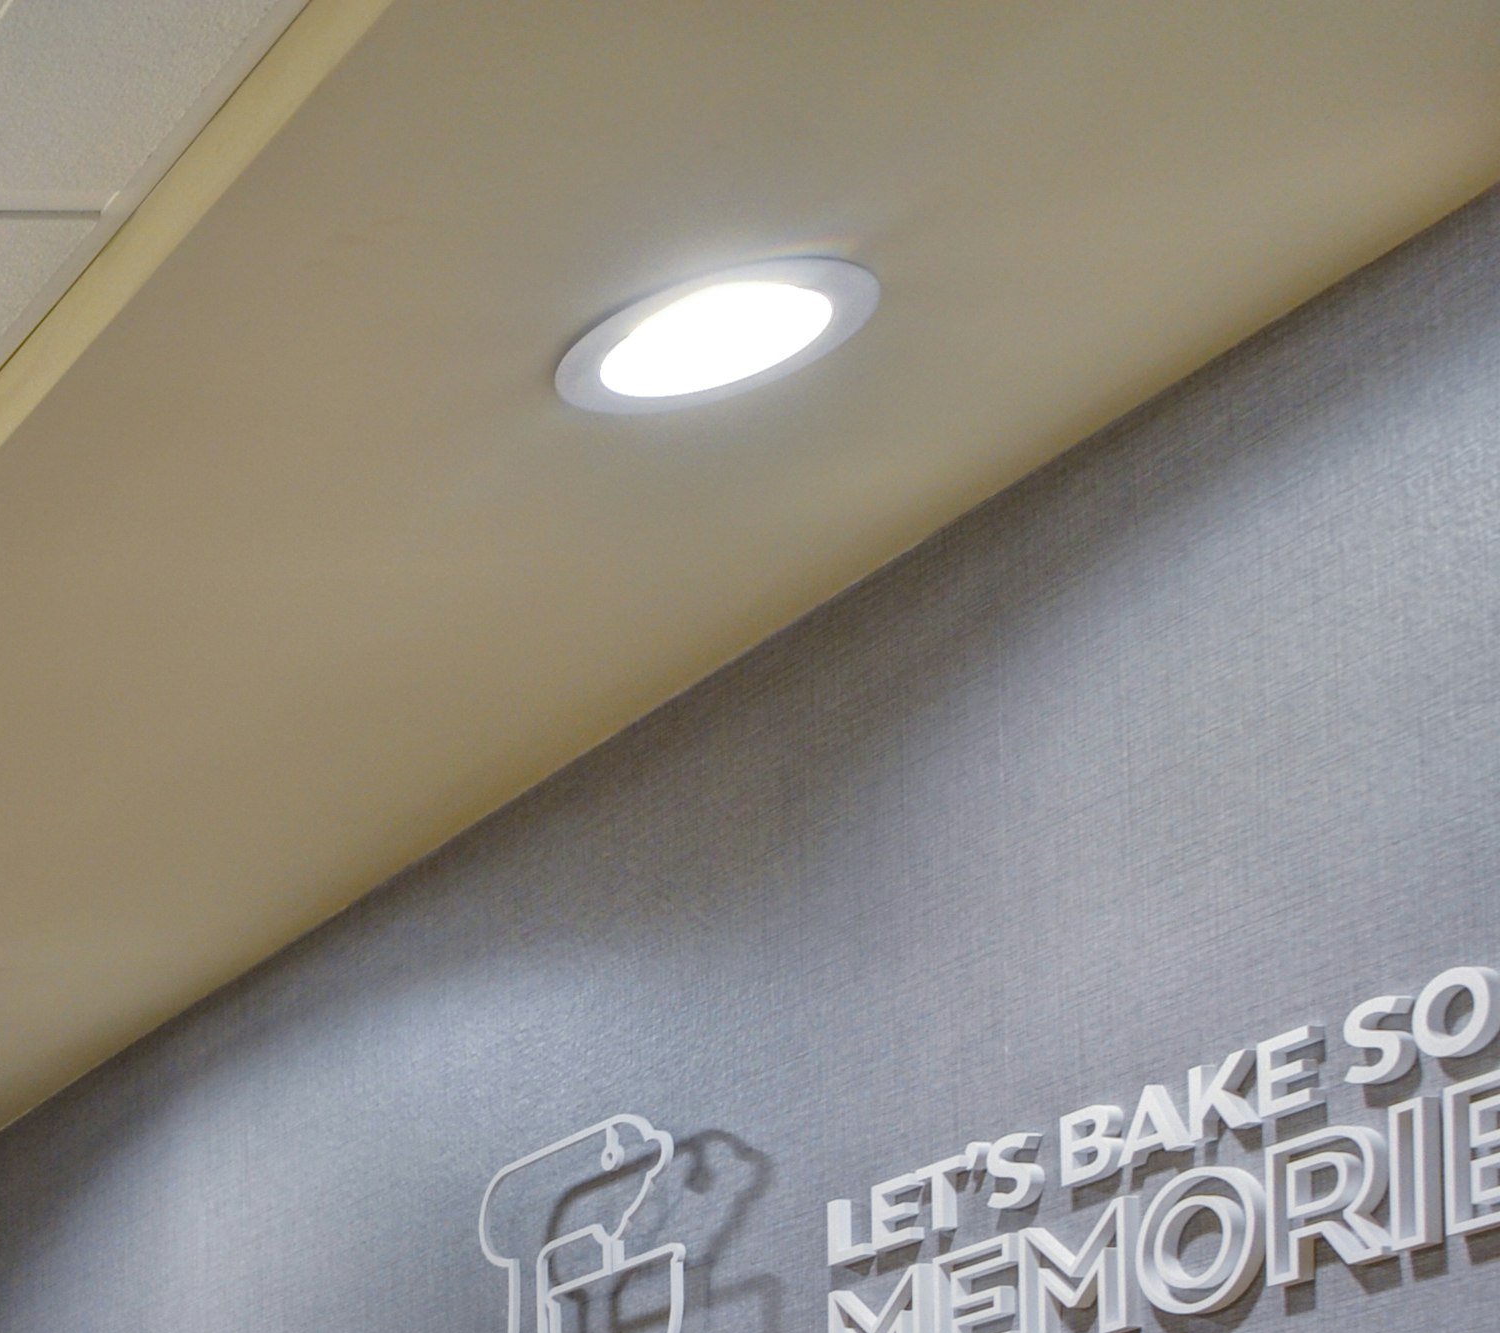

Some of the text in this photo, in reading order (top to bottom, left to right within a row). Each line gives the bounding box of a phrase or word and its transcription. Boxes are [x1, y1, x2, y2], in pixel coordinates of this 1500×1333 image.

[827, 966, 1500, 1267] LET'S BAKE SO
